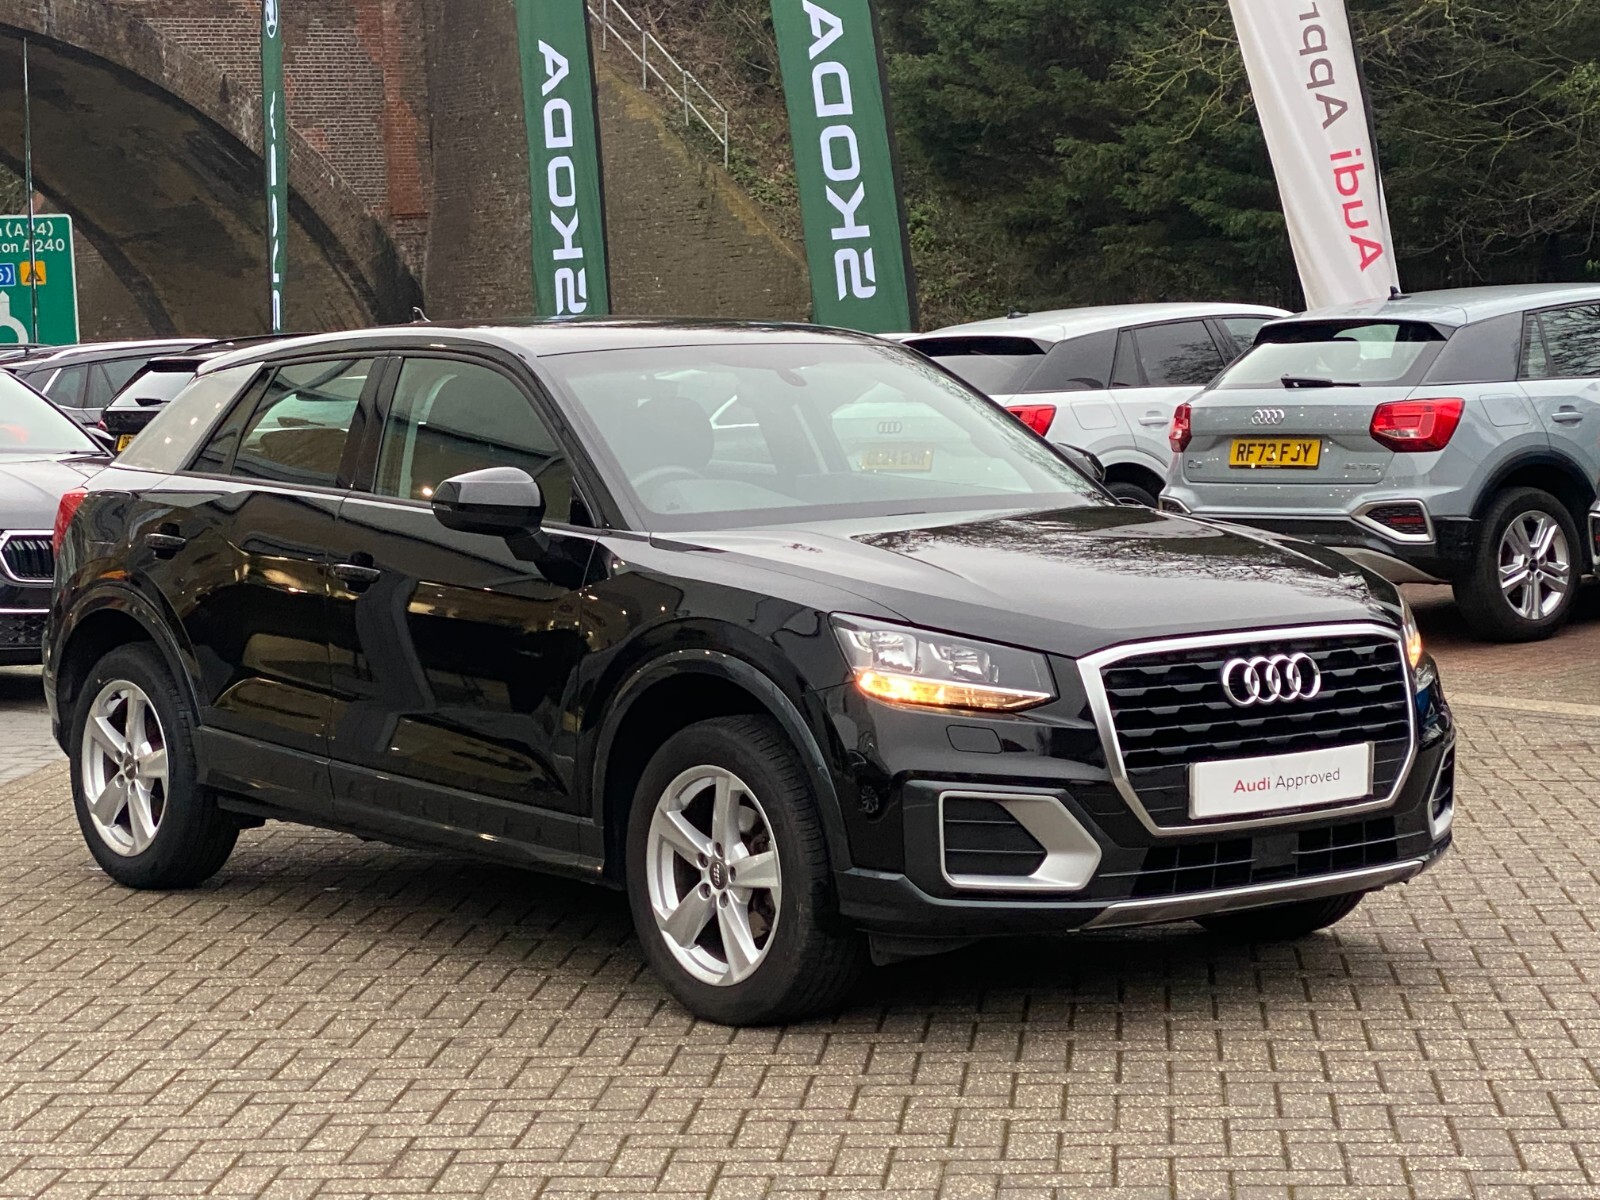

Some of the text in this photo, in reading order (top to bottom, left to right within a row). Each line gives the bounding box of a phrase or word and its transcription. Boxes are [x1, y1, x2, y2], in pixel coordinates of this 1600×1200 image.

[6, 221, 54, 238] (A4)
[1236, 442, 1313, 462] RF73 FJY
[1233, 768, 1340, 793] Audi Approved
